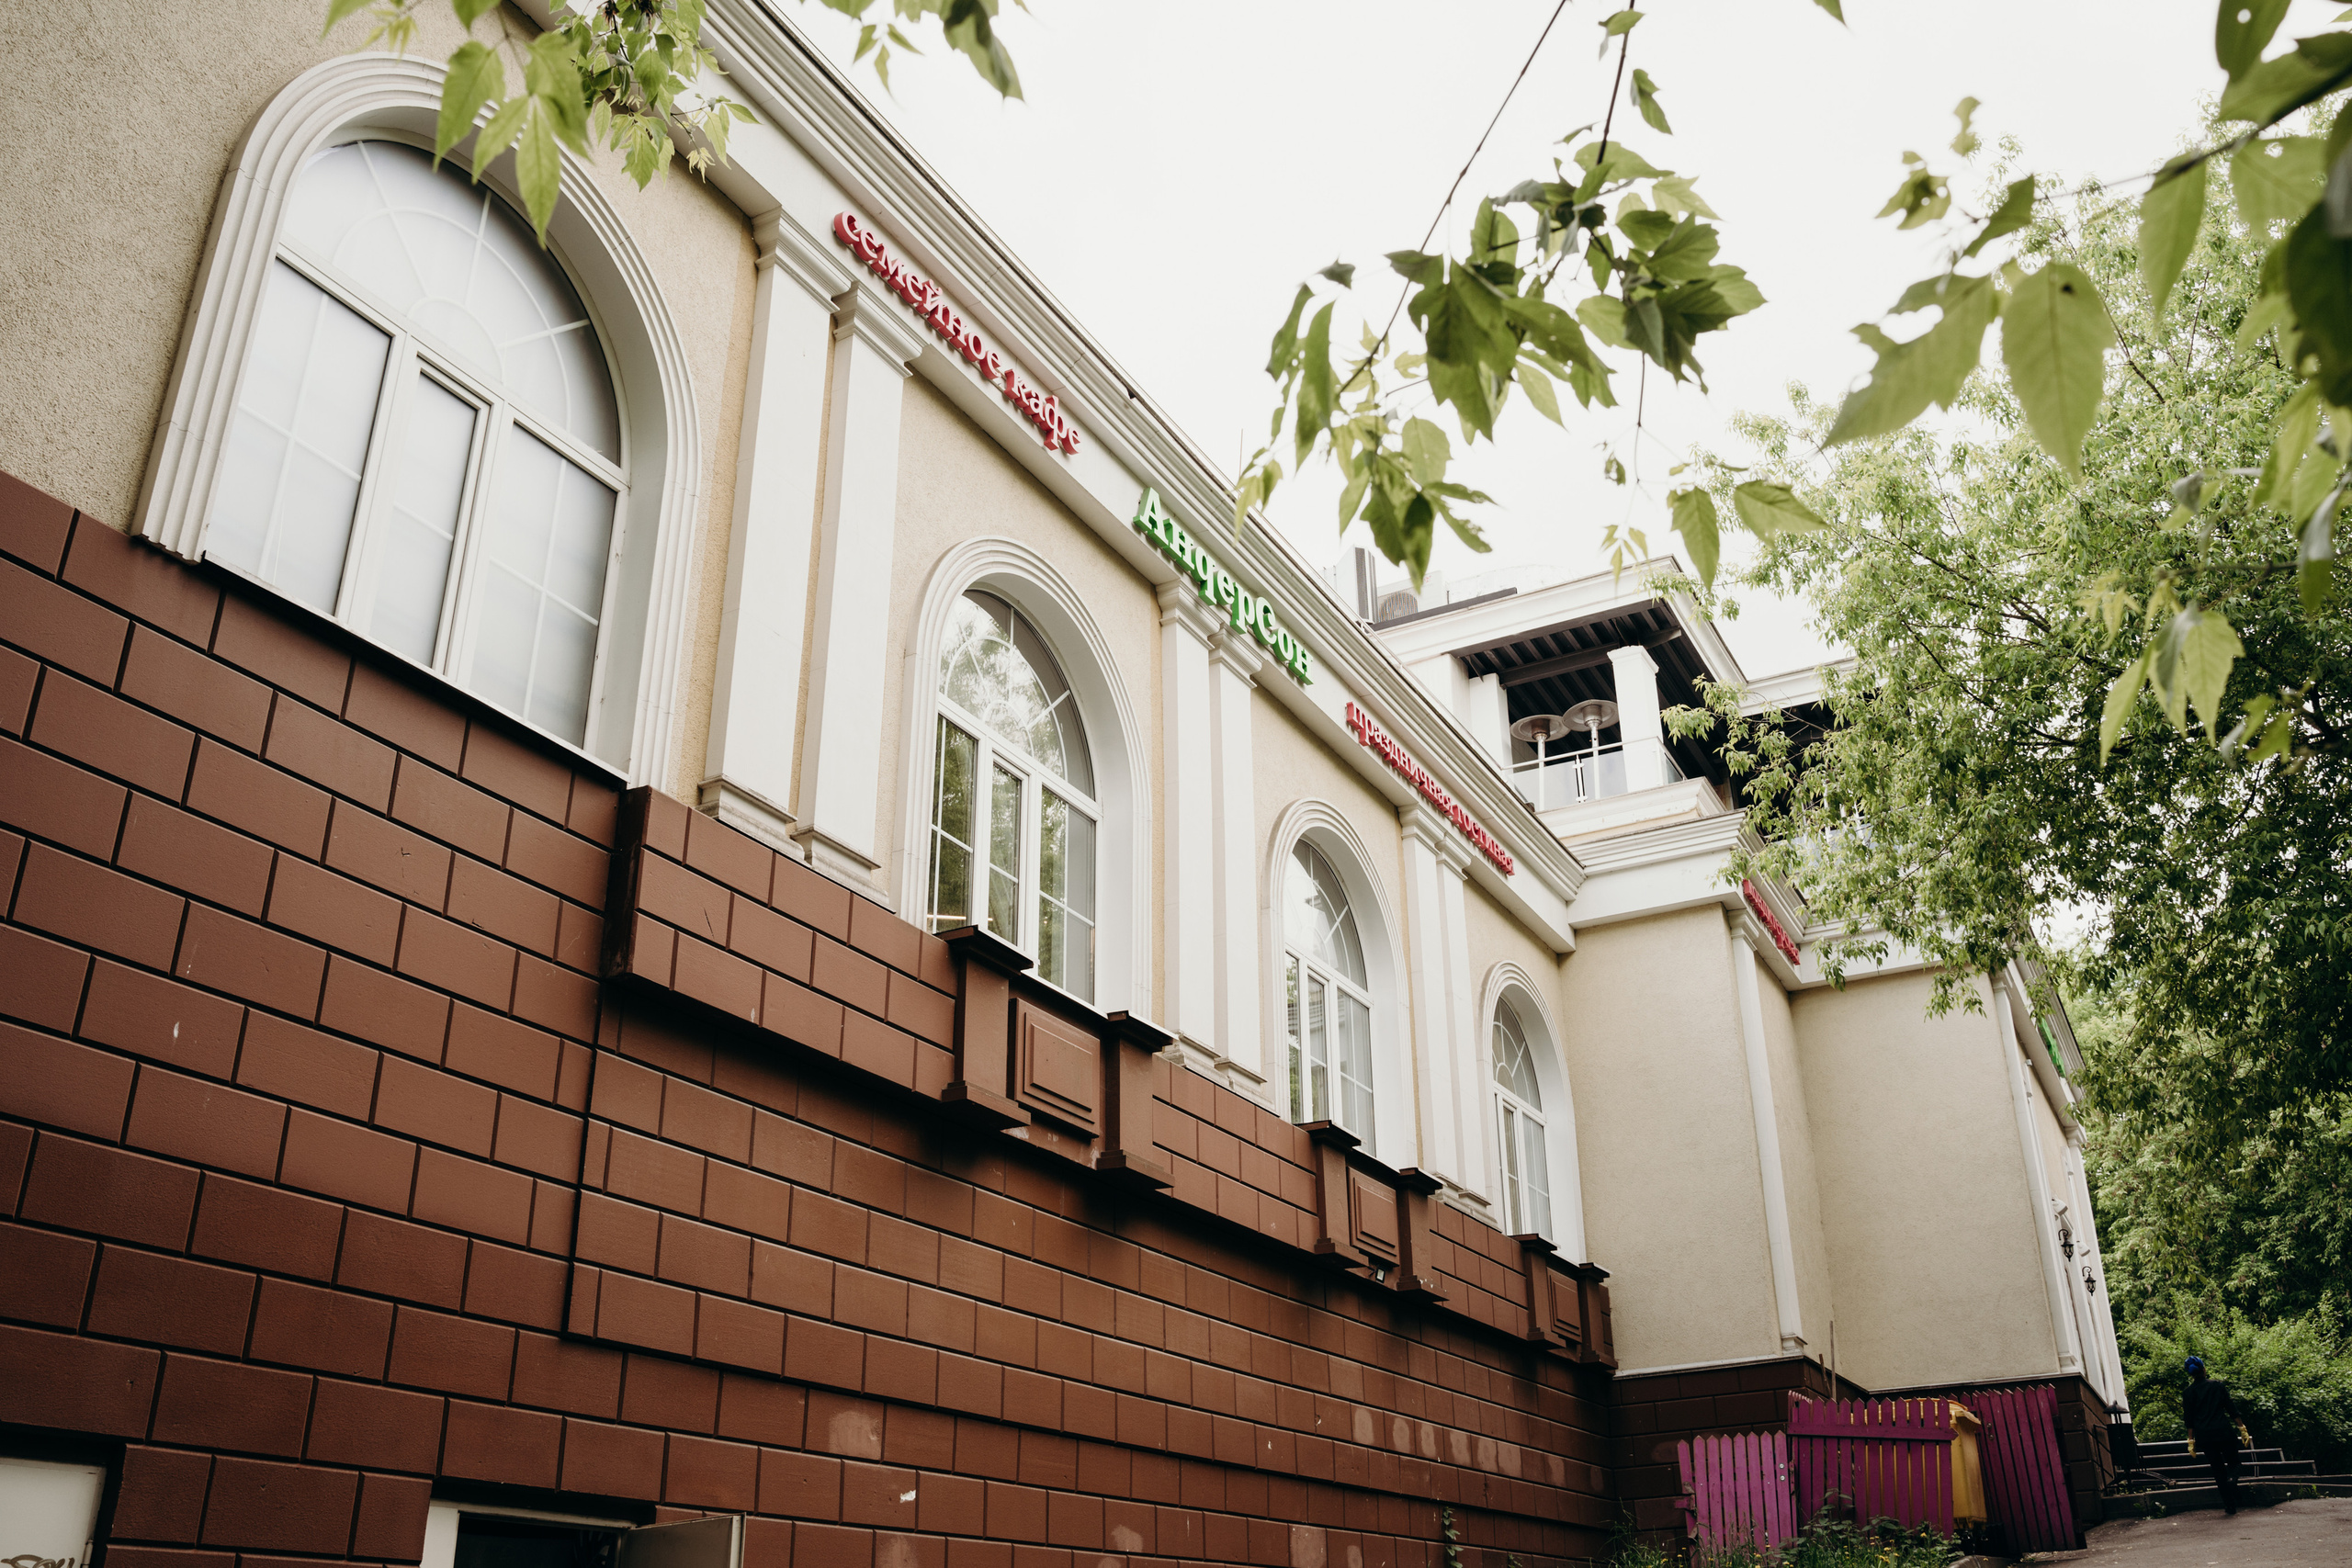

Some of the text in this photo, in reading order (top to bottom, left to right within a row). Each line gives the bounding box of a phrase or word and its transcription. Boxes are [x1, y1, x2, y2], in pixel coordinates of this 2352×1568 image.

[834, 210, 1081, 456] семейное кафе
[1346, 702, 1515, 876] праздничная гостиная
